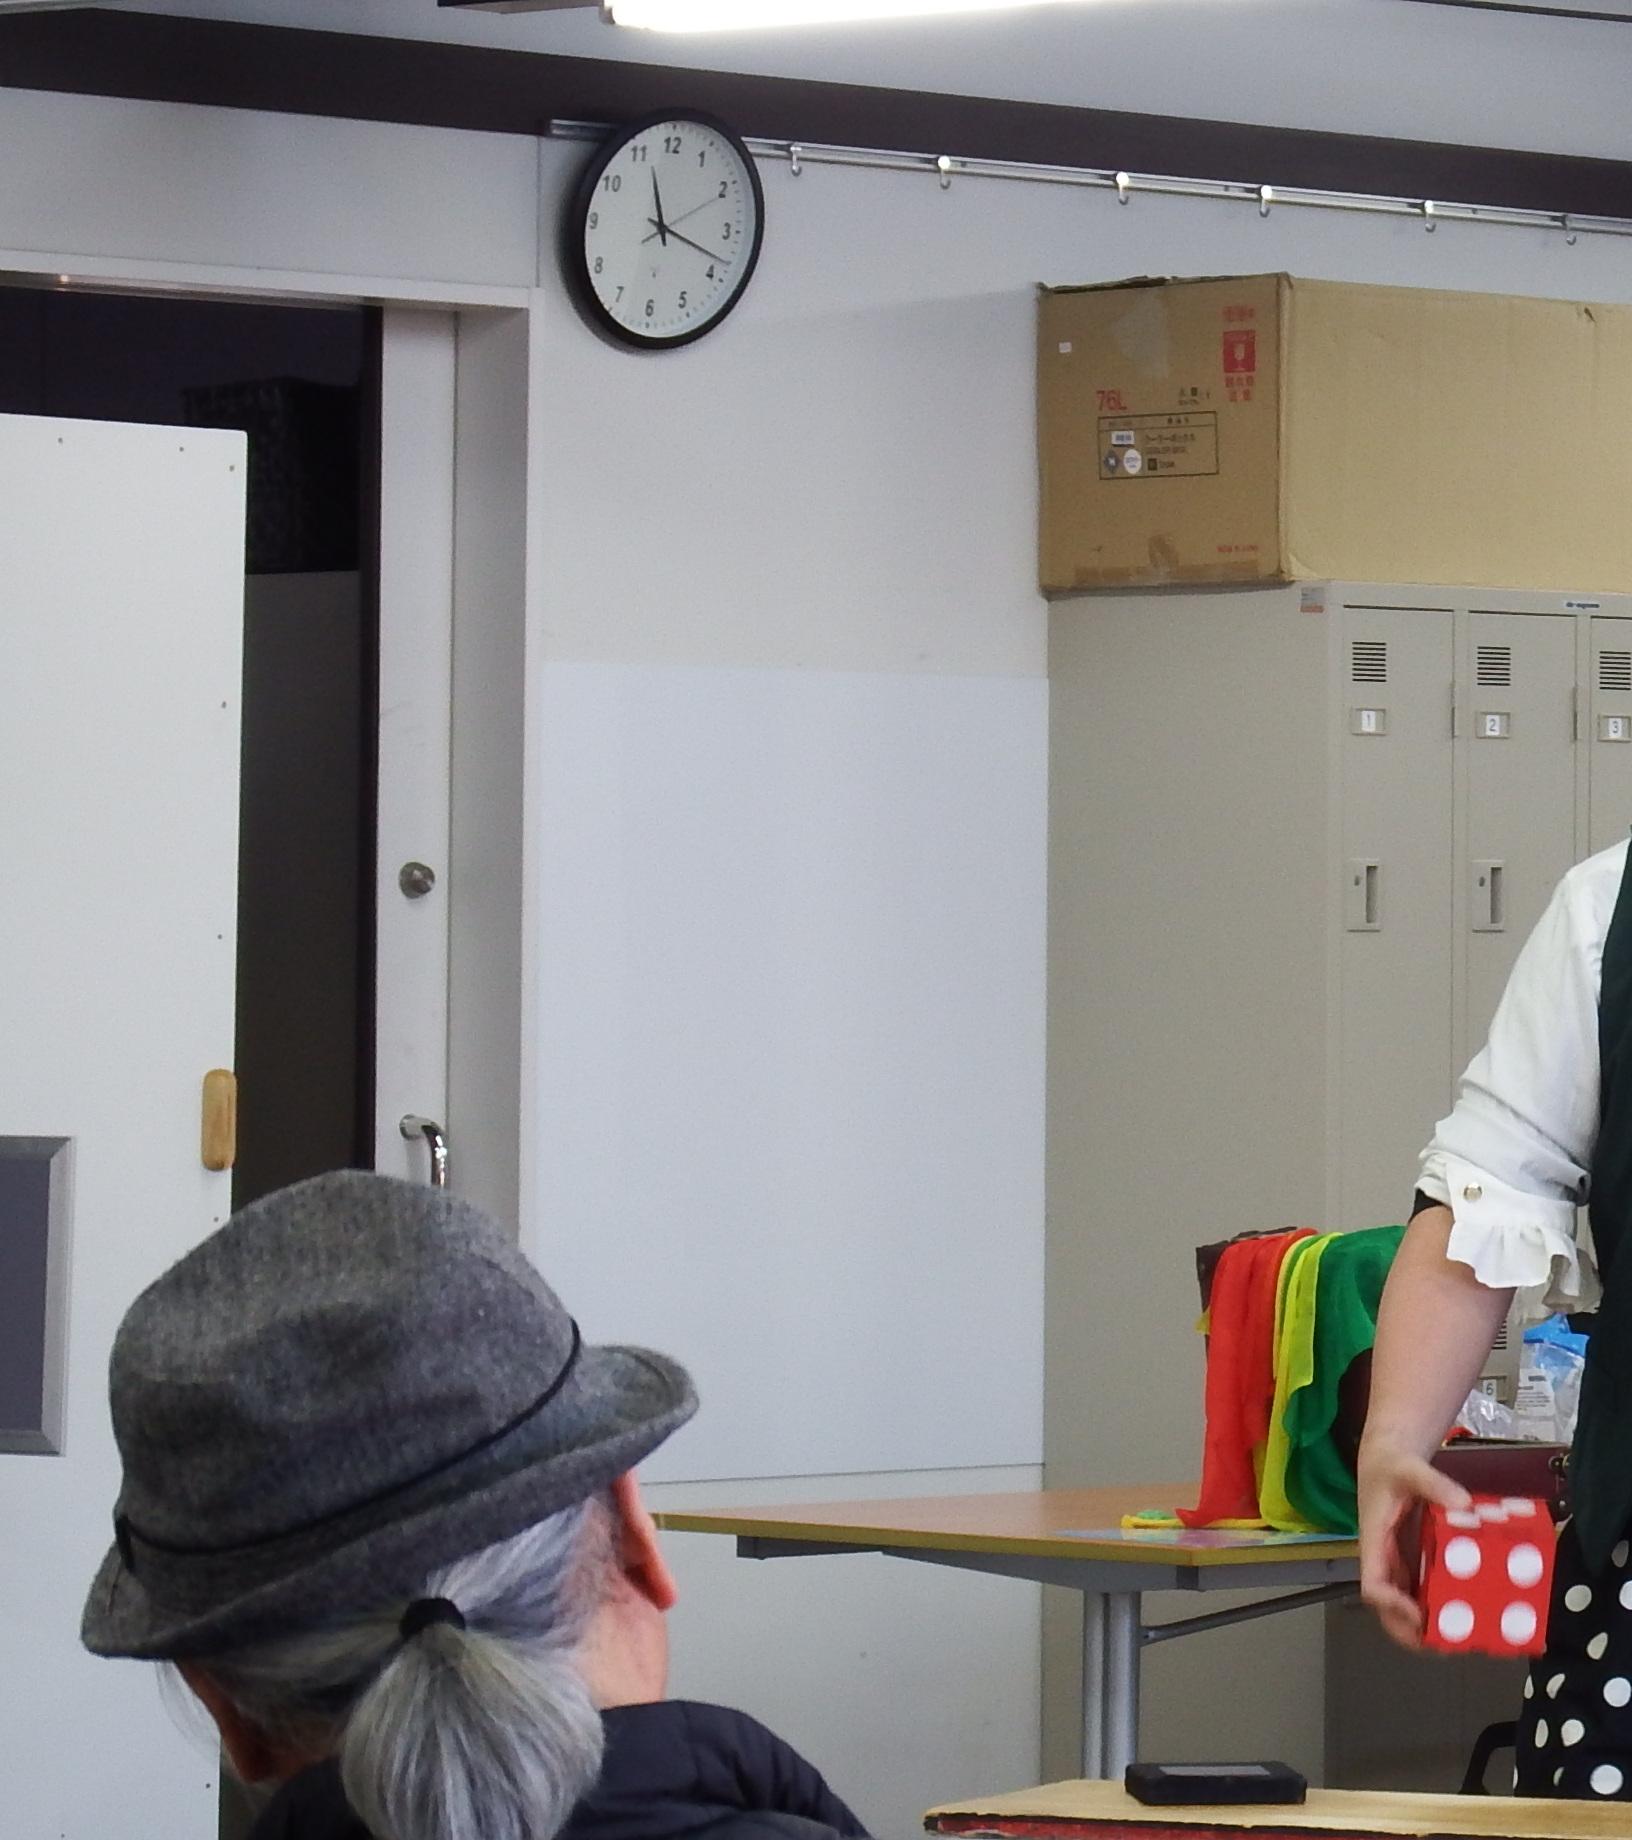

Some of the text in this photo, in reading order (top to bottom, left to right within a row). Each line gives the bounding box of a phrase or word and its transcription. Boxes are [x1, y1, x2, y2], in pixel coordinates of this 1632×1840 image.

[631, 145, 648, 162] 11
[663, 136, 682, 154] 12
[698, 151, 705, 168] 1
[603, 175, 622, 192] 10
[718, 181, 728, 199] 2
[589, 212, 599, 229] 9
[722, 222, 731, 240] 3
[594, 256, 604, 274] 8
[705, 264, 715, 279] 4
[615, 286, 625, 303] 7
[678, 291, 687, 309] 5
[645, 299, 654, 317] 6
[1366, 714, 1371, 727] 1
[1489, 718, 1497, 732] 2
[1612, 720, 1620, 734] 3
[1486, 1383, 1493, 1396] 6
